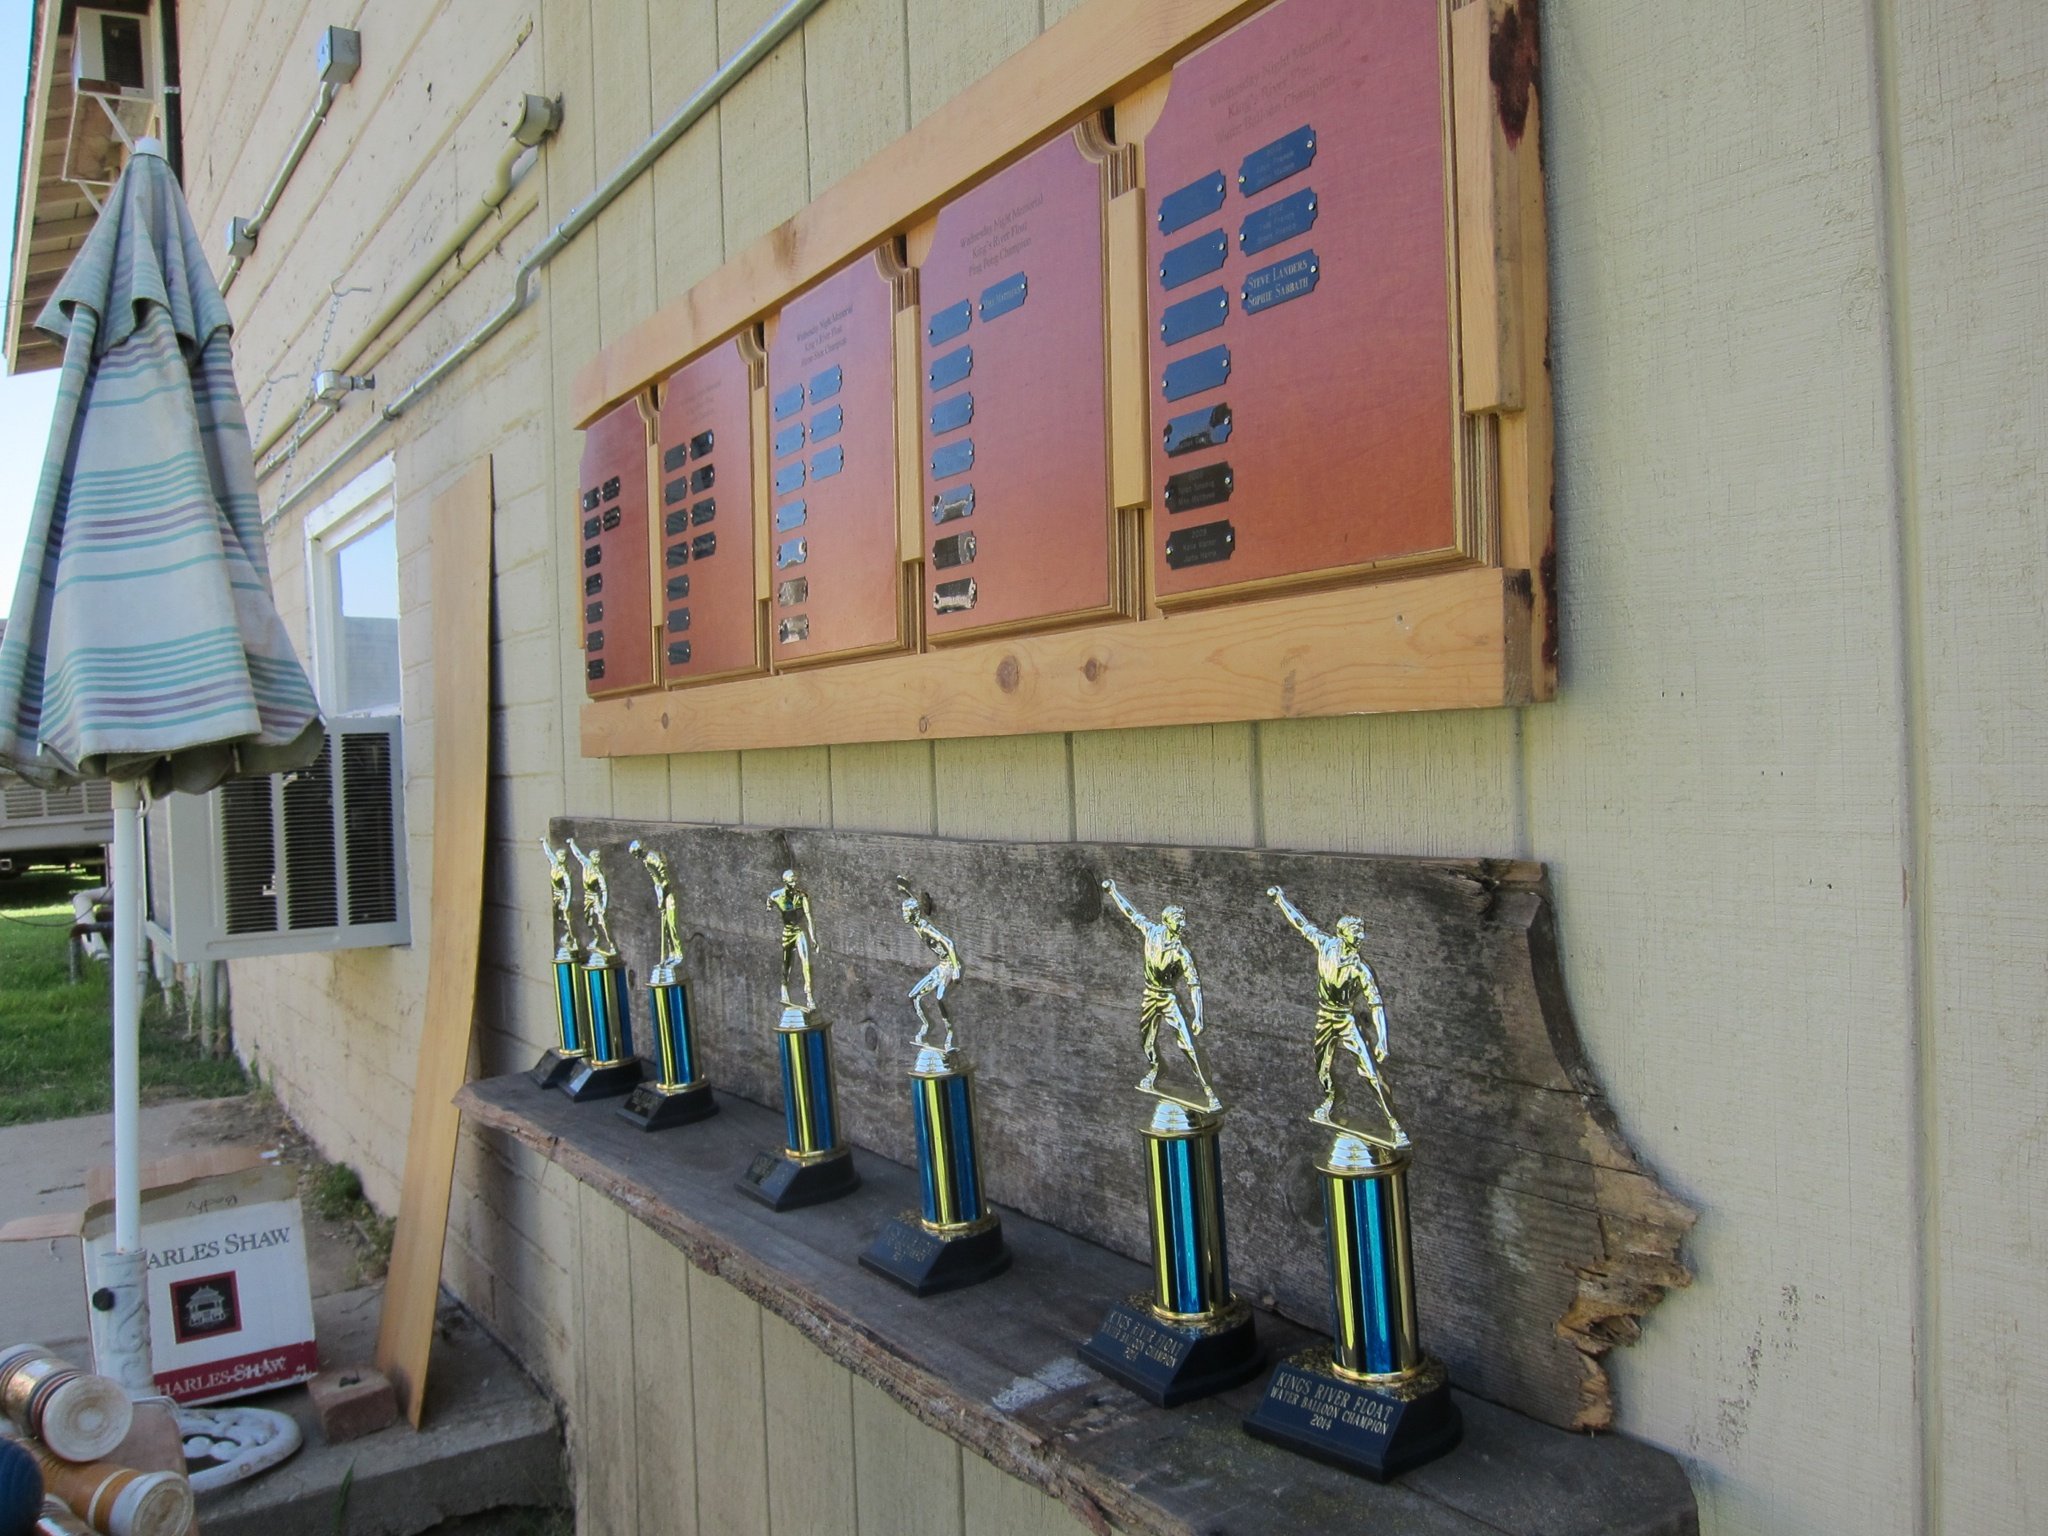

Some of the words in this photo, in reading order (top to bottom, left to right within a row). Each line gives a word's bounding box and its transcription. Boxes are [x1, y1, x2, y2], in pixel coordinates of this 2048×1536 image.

[1248, 274, 1271, 291] STEVE
[1273, 260, 1308, 281] LANDERS
[1275, 277, 1309, 298] SABBATH
[147, 1240, 220, 1269] ARLES
[157, 1369, 230, 1396] HARLES
[1276, 1372, 1313, 1395] KINGS
[1314, 1384, 1351, 1408] RIVER
[1352, 1395, 1394, 1422] FLOAT
[1270, 1386, 1300, 1406] WATER
[1301, 1397, 1340, 1420] BALLOON
[1341, 1410, 1390, 1436] CHAMPION
